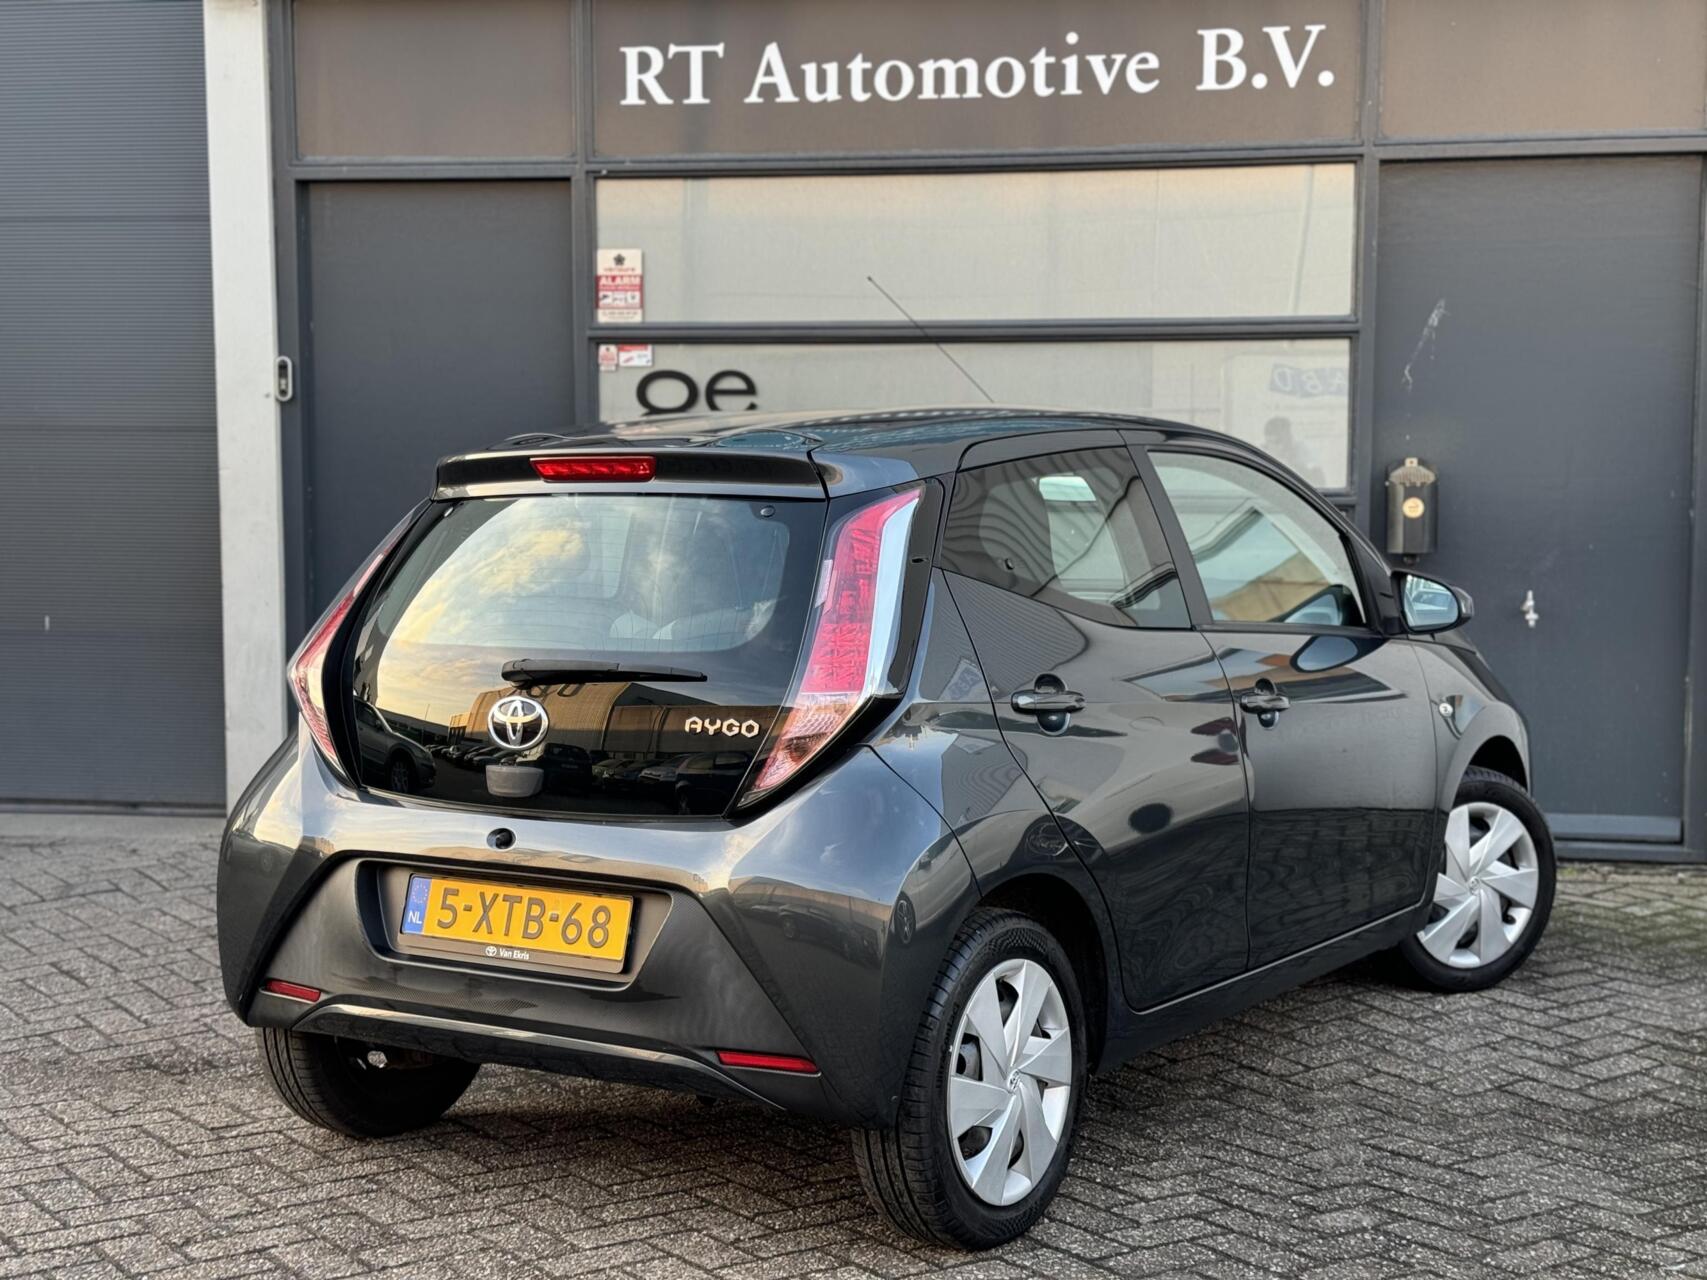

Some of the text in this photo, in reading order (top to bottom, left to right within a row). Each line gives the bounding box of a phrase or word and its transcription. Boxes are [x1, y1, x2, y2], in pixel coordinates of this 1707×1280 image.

[619, 23, 1335, 106] RT Automotive B.V.
[684, 716, 760, 738] AYGO
[408, 911, 422, 924] NL
[436, 887, 612, 949] 5-XTB-68
[499, 948, 513, 958] Van
